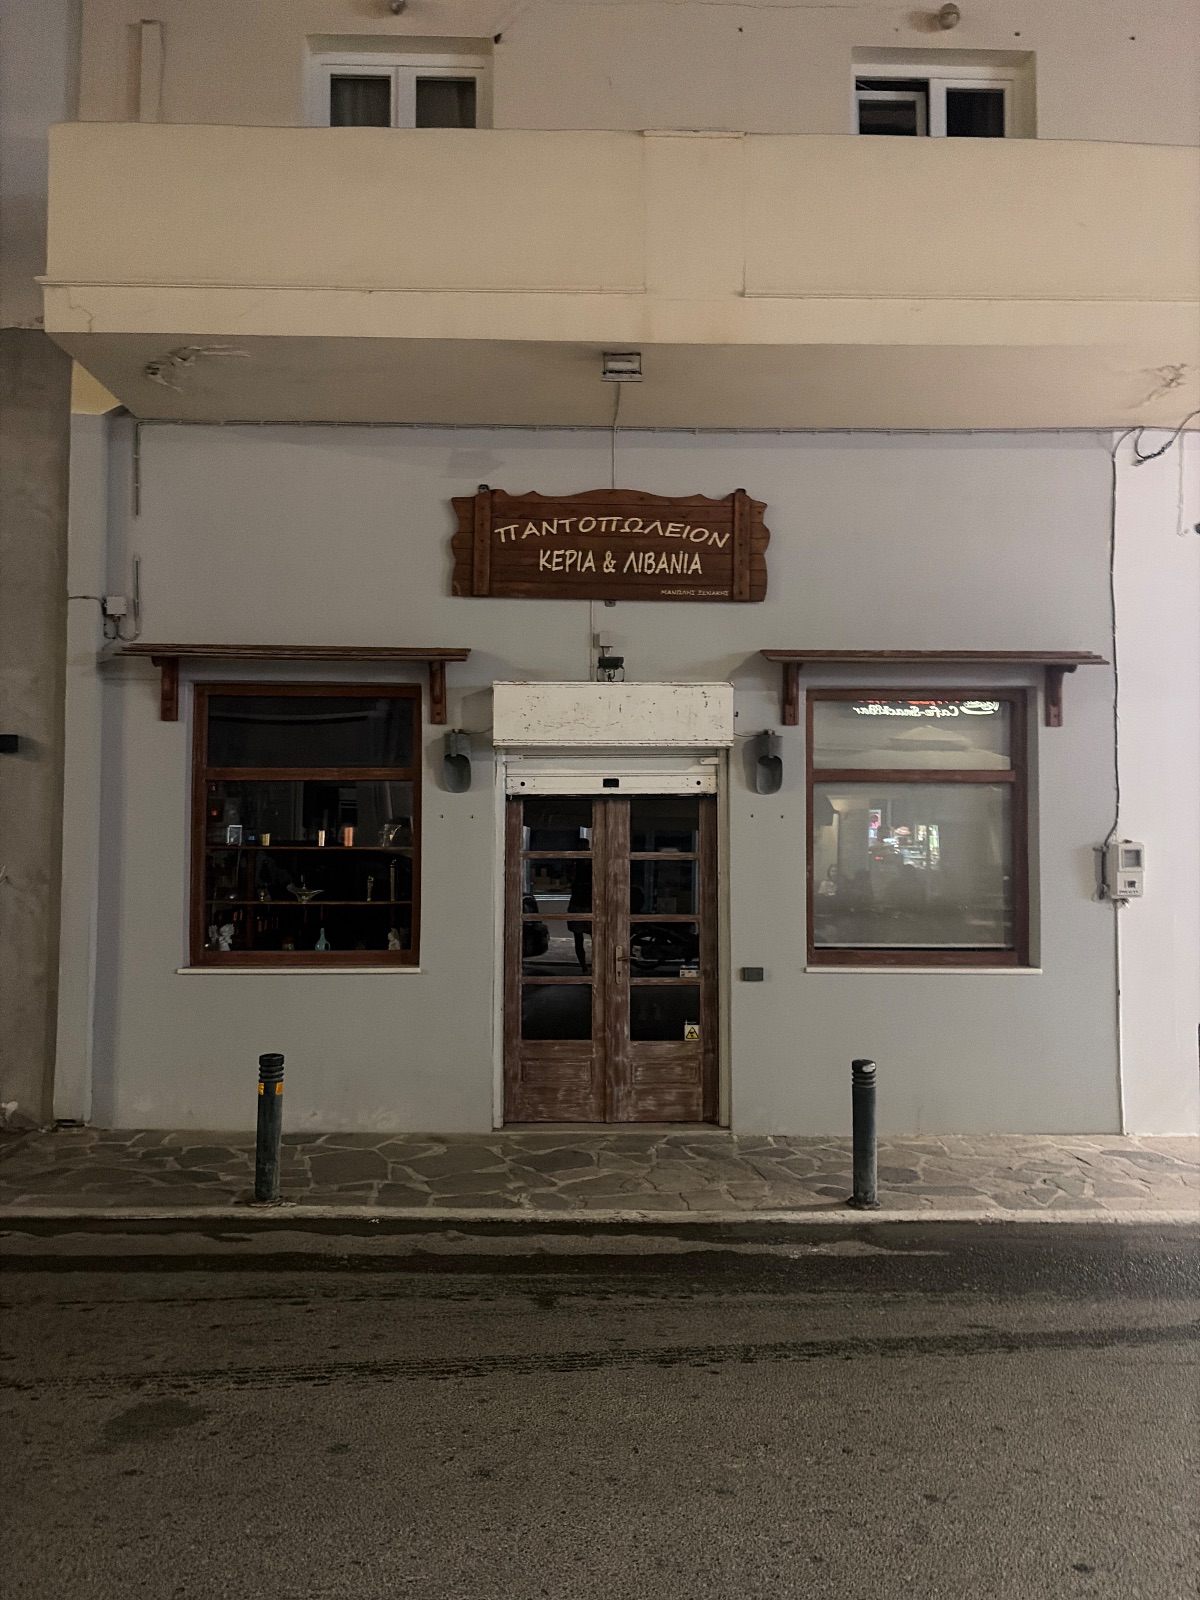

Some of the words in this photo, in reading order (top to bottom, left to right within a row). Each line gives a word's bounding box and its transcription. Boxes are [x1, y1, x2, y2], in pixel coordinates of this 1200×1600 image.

[494, 516, 730, 548] ΠΑΝΤΟΠΩΛΕΙΟΝ
[539, 548, 596, 573] ΚΕΡΙΑ
[603, 550, 617, 573] &
[623, 550, 703, 575] ΛΙΒΑΝΙΑ
